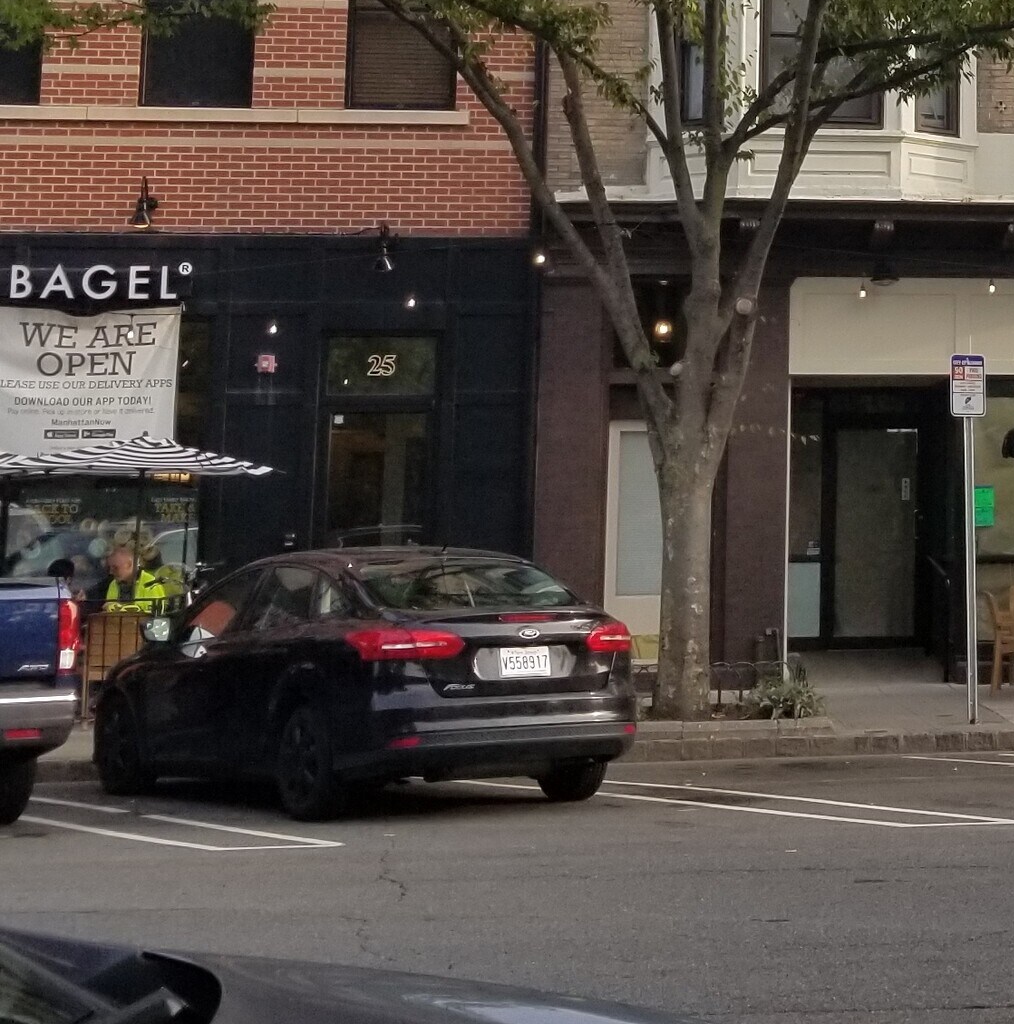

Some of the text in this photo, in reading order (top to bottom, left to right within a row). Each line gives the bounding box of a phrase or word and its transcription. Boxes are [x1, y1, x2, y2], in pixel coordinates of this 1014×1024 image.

[19, 321, 157, 348] WE ARE
[36, 351, 137, 377] OPEN
[367, 354, 397, 377] 25
[38, 380, 60, 389] USE
[62, 380, 86, 389] OUR
[88, 379, 143, 390] DELIVERY
[145, 378, 173, 388] APPS
[14, 396, 152, 406] DOWNLOAD OUR APP TODAY!
[51, 418, 112, 426] ManhattanNow
